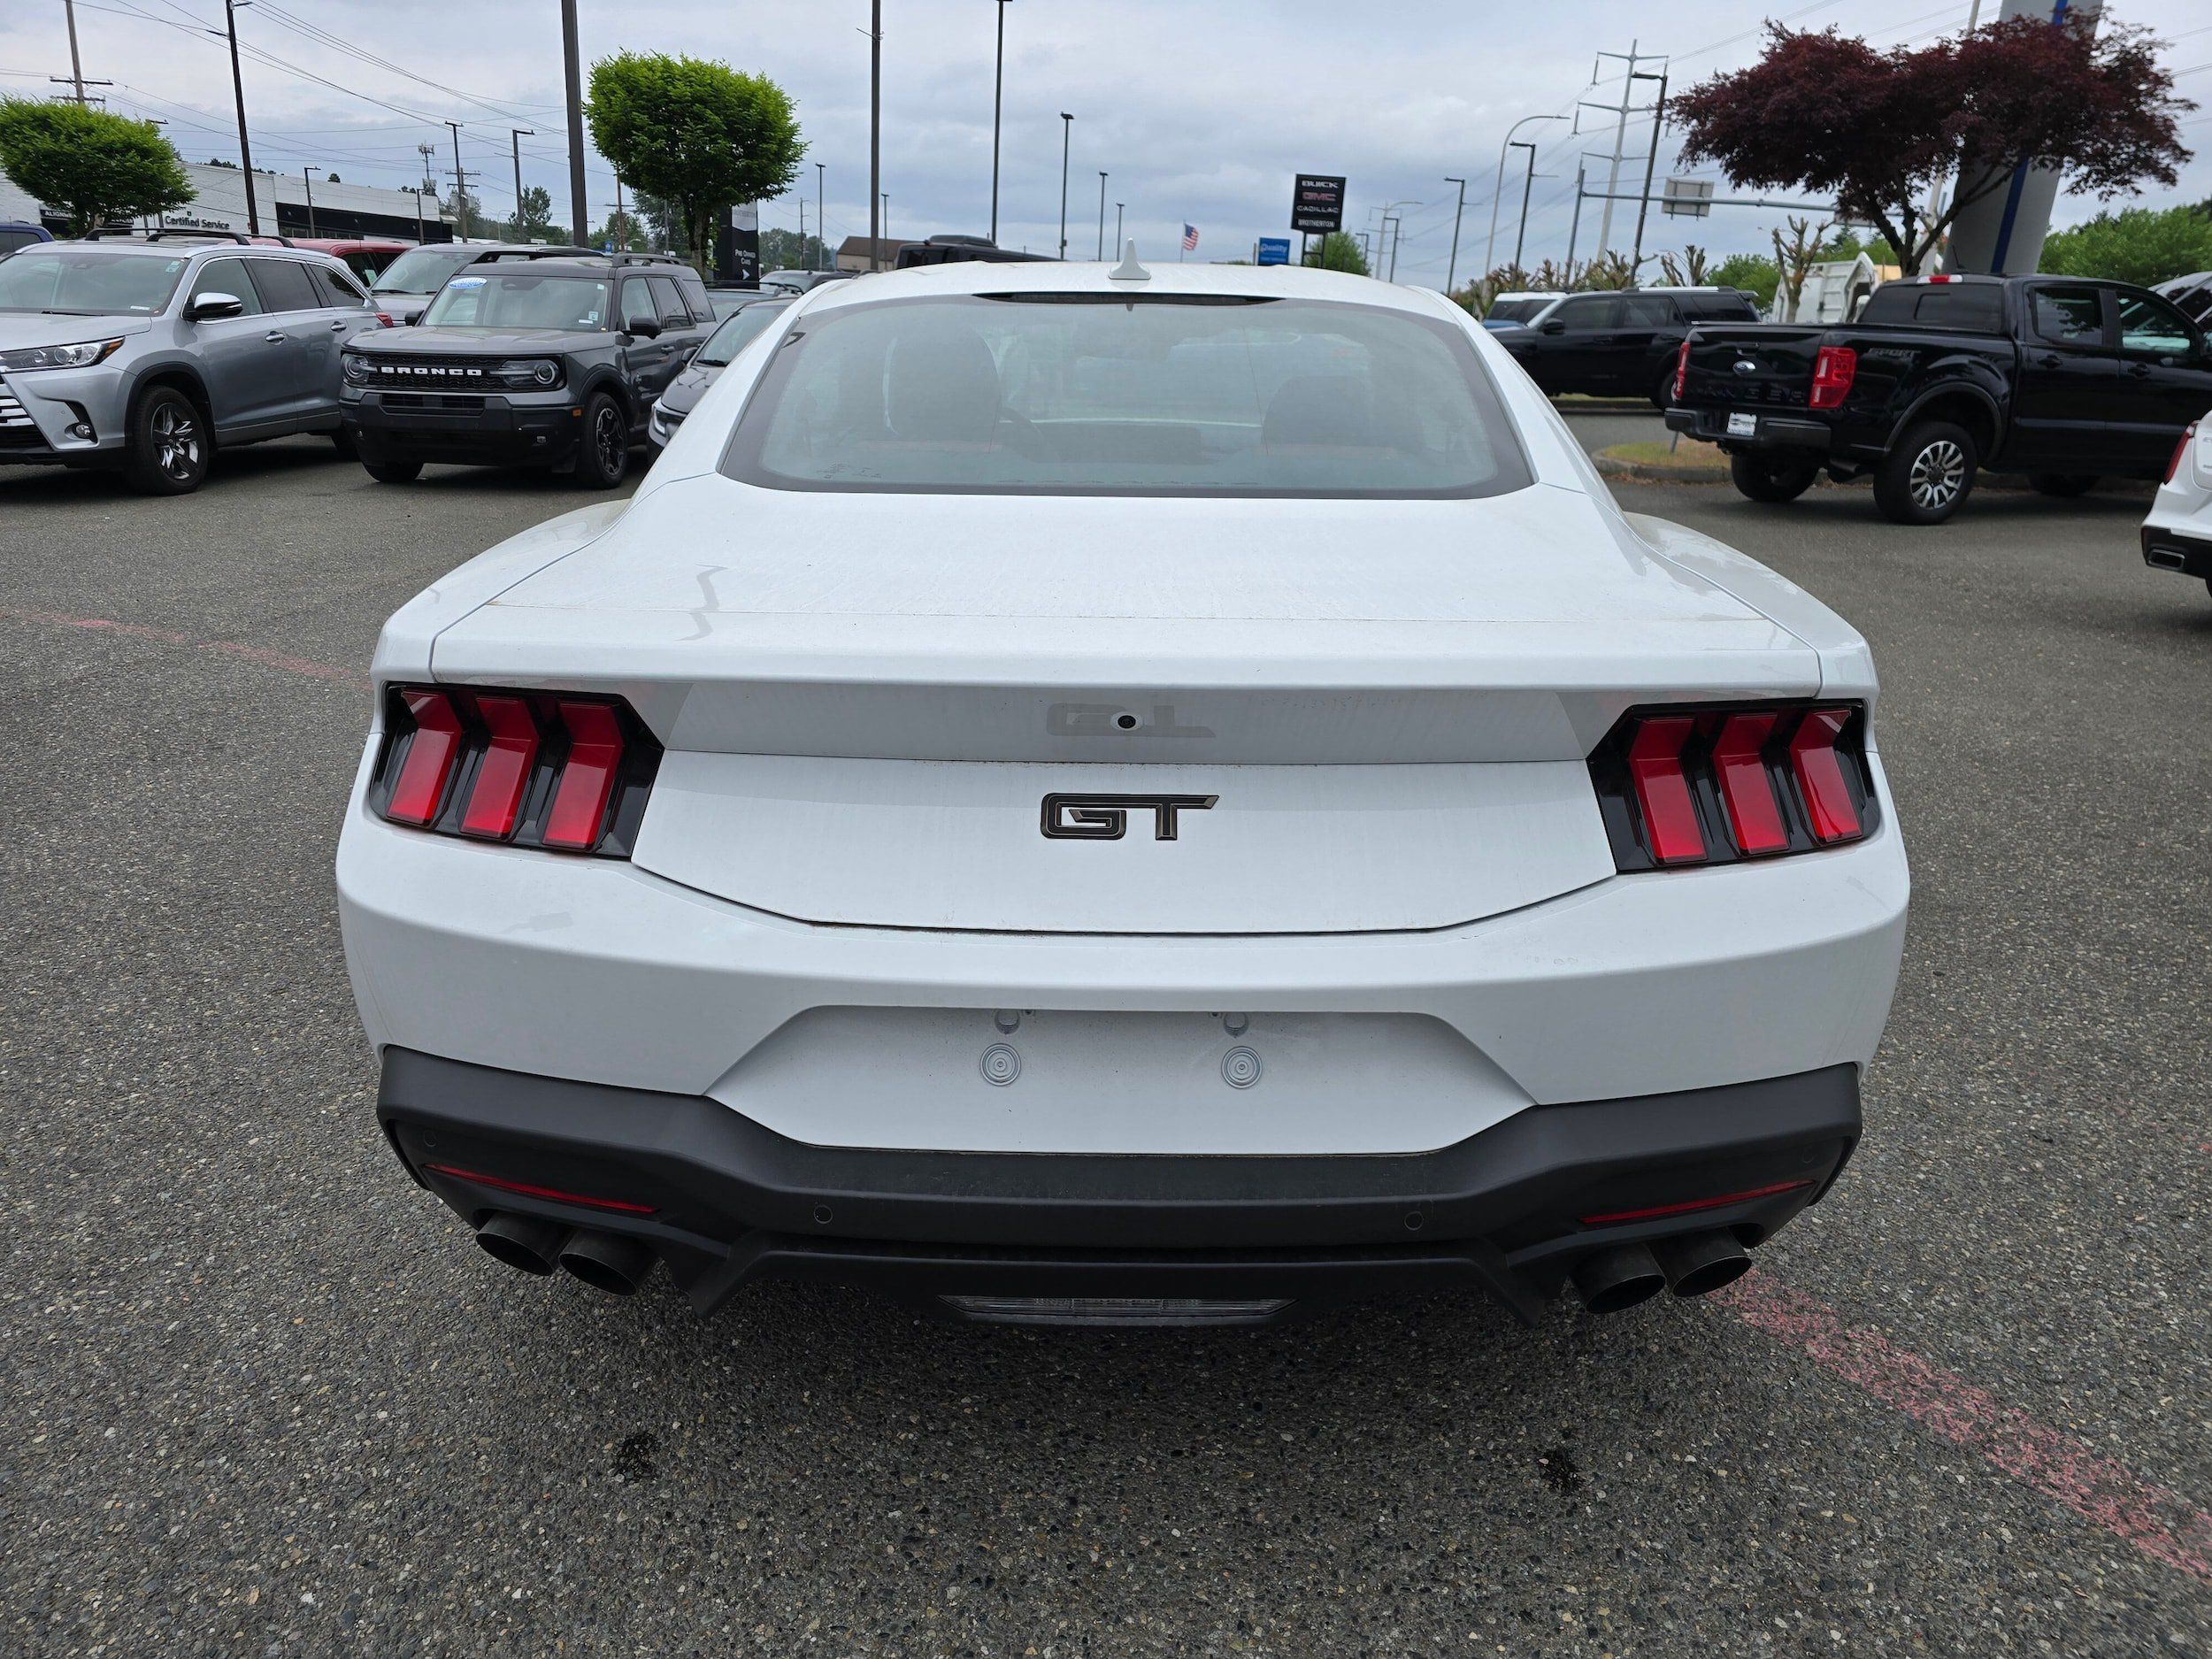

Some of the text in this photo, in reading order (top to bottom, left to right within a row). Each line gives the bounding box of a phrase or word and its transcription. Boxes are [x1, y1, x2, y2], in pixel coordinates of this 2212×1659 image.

[1302, 180, 1339, 188] BUICK
[1302, 191, 1336, 201] GMC
[1296, 204, 1339, 213] CADILLAC
[165, 216, 230, 229] Certified Service
[381, 366, 482, 376] BRONCO
[1040, 793, 1219, 841] GT
